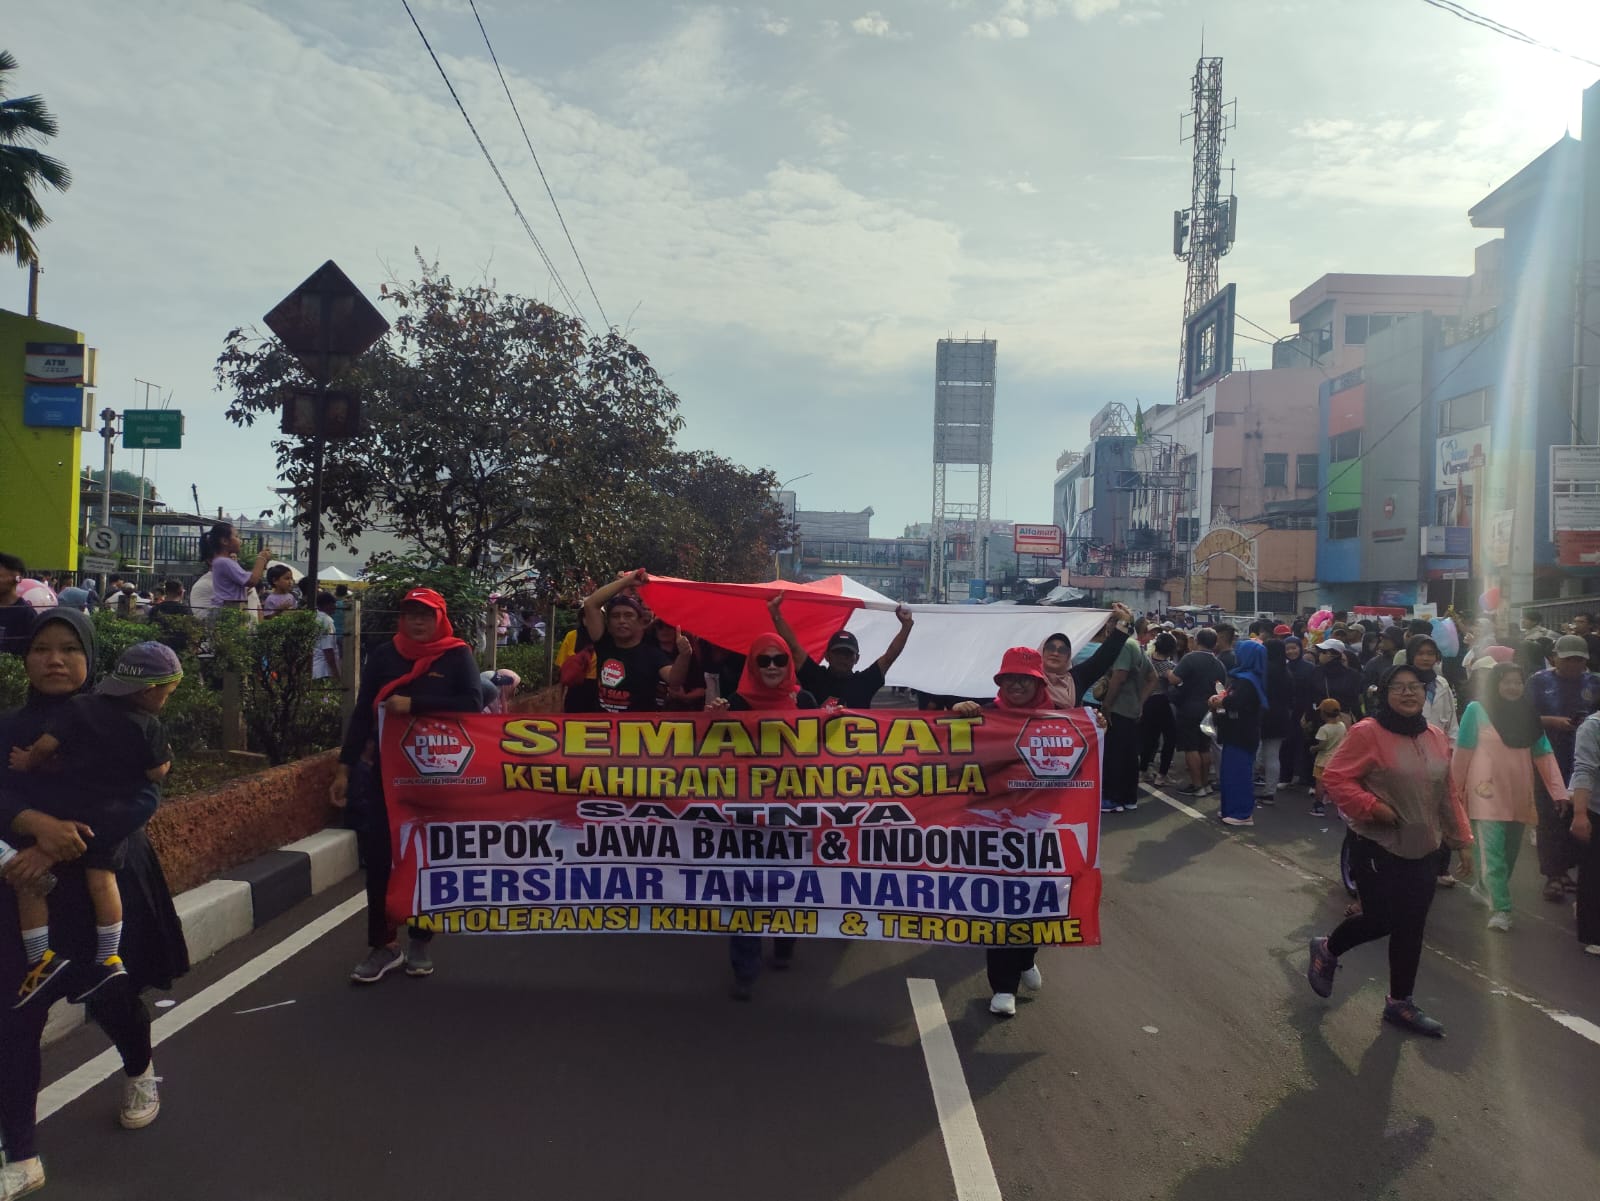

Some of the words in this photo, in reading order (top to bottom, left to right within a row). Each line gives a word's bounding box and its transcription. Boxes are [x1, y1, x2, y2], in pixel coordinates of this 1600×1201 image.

[95, 531, 112, 549] S
[1019, 527, 1057, 537] Alfamart
[117, 662, 145, 676] DKNY
[501, 716, 984, 757] SEMANGAT
[1030, 736, 1074, 756] PNIB
[503, 764, 737, 798] KELAHIRAN
[750, 763, 987, 798] PANCASILA
[578, 801, 914, 827] SAATNYA
[430, 823, 563, 862] DEPOK,
[576, 824, 680, 860] JAWA
[692, 827, 808, 861] BARAT
[820, 830, 847, 861] &
[861, 828, 1063, 870] INDONESIA
[430, 867, 664, 906] BERSINAR
[680, 868, 824, 905] TANPA
[841, 870, 1060, 916] NARKOBA
[651, 907, 818, 935] KHILAFAH
[839, 912, 869, 936] &
[879, 913, 1083, 945] TERORISME
